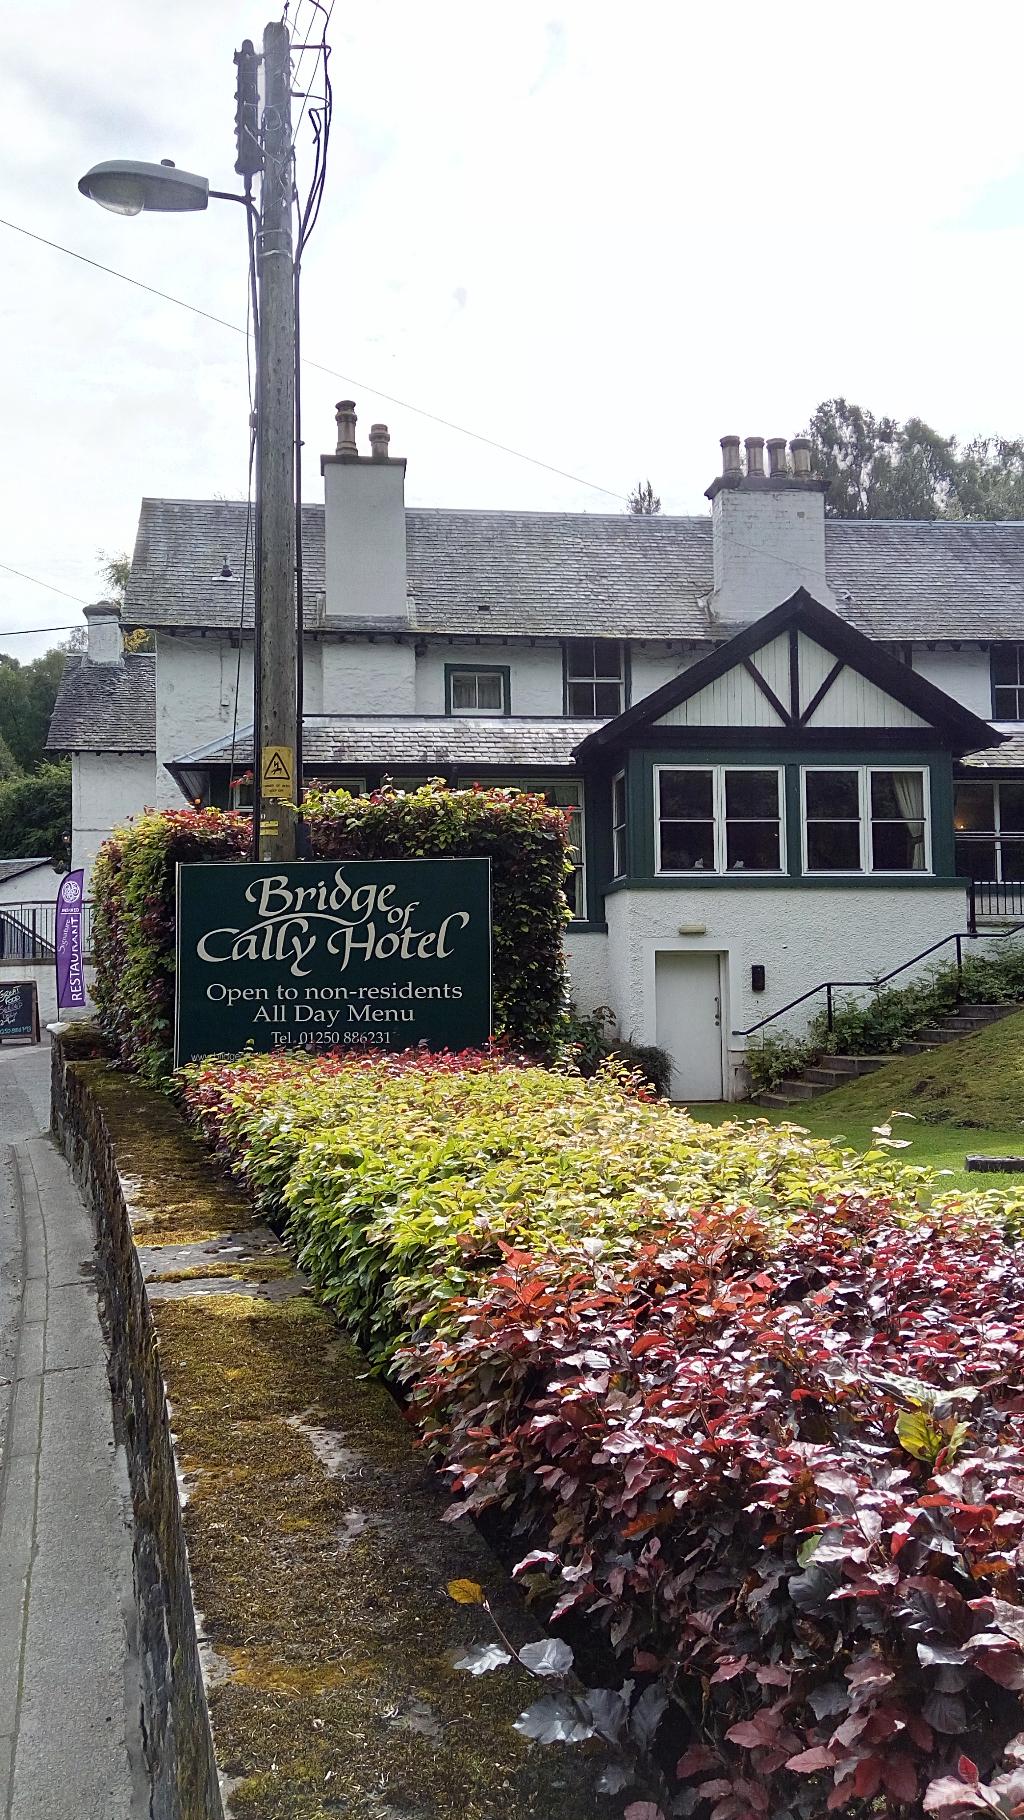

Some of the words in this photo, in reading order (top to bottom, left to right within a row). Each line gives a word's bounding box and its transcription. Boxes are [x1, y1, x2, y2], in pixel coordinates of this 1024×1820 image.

[245, 866, 397, 926] Bridge
[387, 901, 421, 931] of
[69, 916, 83, 1001] RESTAURANT
[196, 918, 317, 977] Cally
[327, 911, 470, 972] Hotel
[206, 983, 270, 1006] Open
[276, 986, 299, 1000] to
[304, 981, 463, 1000] non-residents
[252, 1005, 286, 1023] All
[294, 1005, 340, 1027] Day
[346, 1005, 415, 1022] Menu
[299, 1031, 340, 1044] 01250
[343, 1031, 391, 1044] 886231
